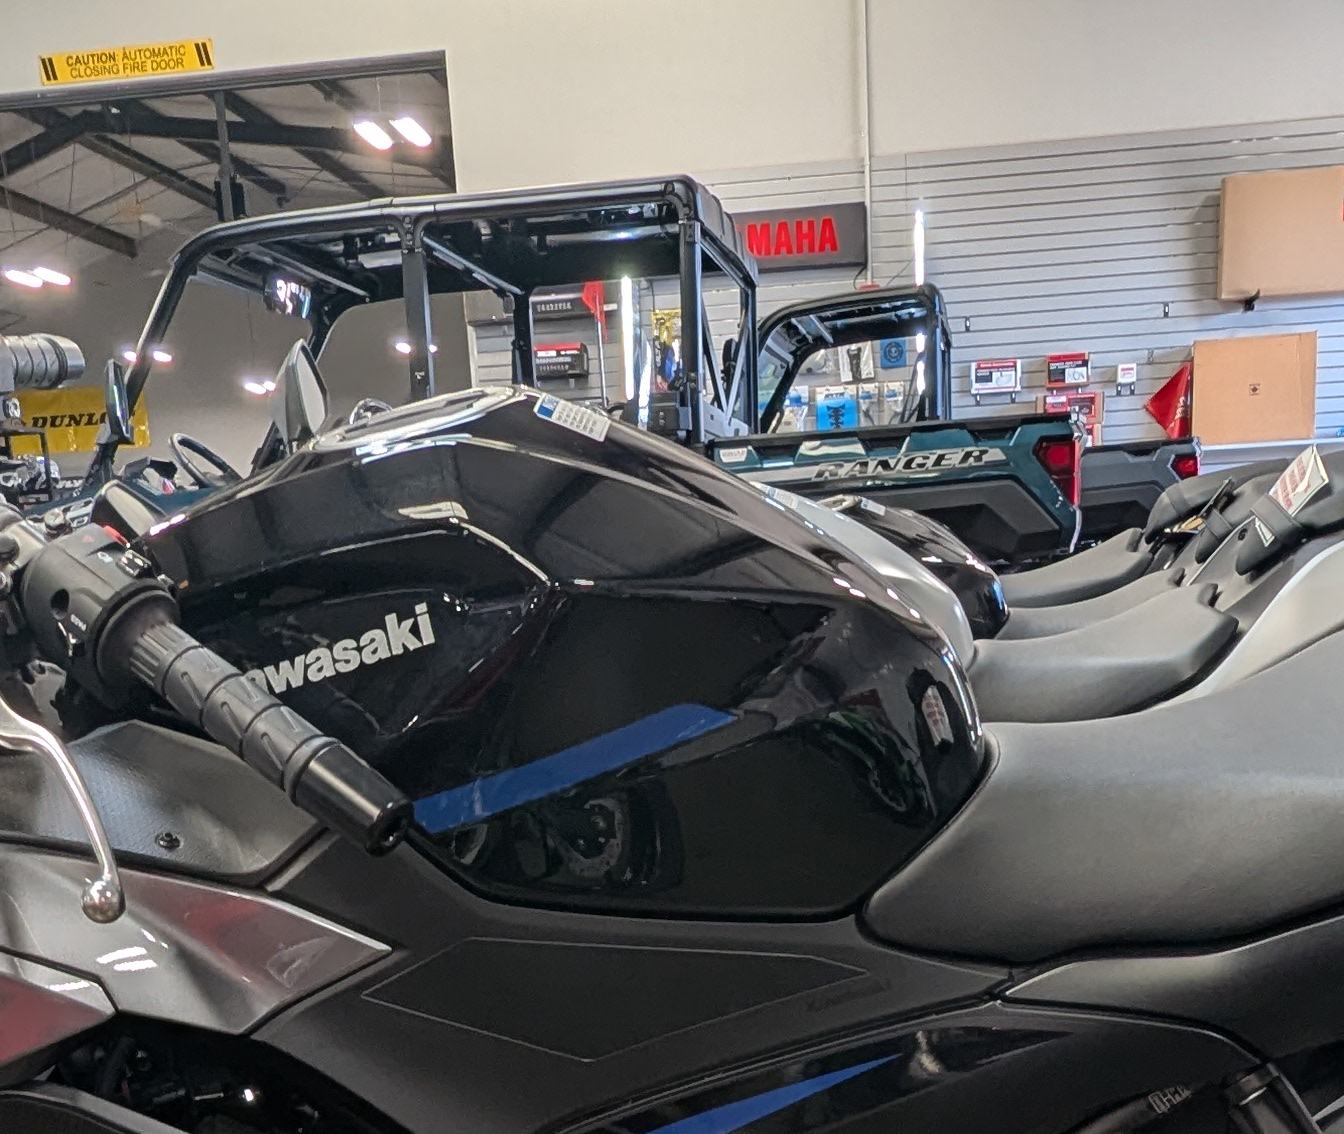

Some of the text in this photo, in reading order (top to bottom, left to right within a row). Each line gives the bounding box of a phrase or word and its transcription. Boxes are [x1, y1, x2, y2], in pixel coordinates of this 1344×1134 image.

[70, 57, 185, 79] CLOSING FIRE DOOR
[122, 45, 186, 62] AUTOMATIC
[746, 217, 839, 256] MAHA
[812, 449, 989, 481] RANGER
[244, 602, 436, 694] awasaki
